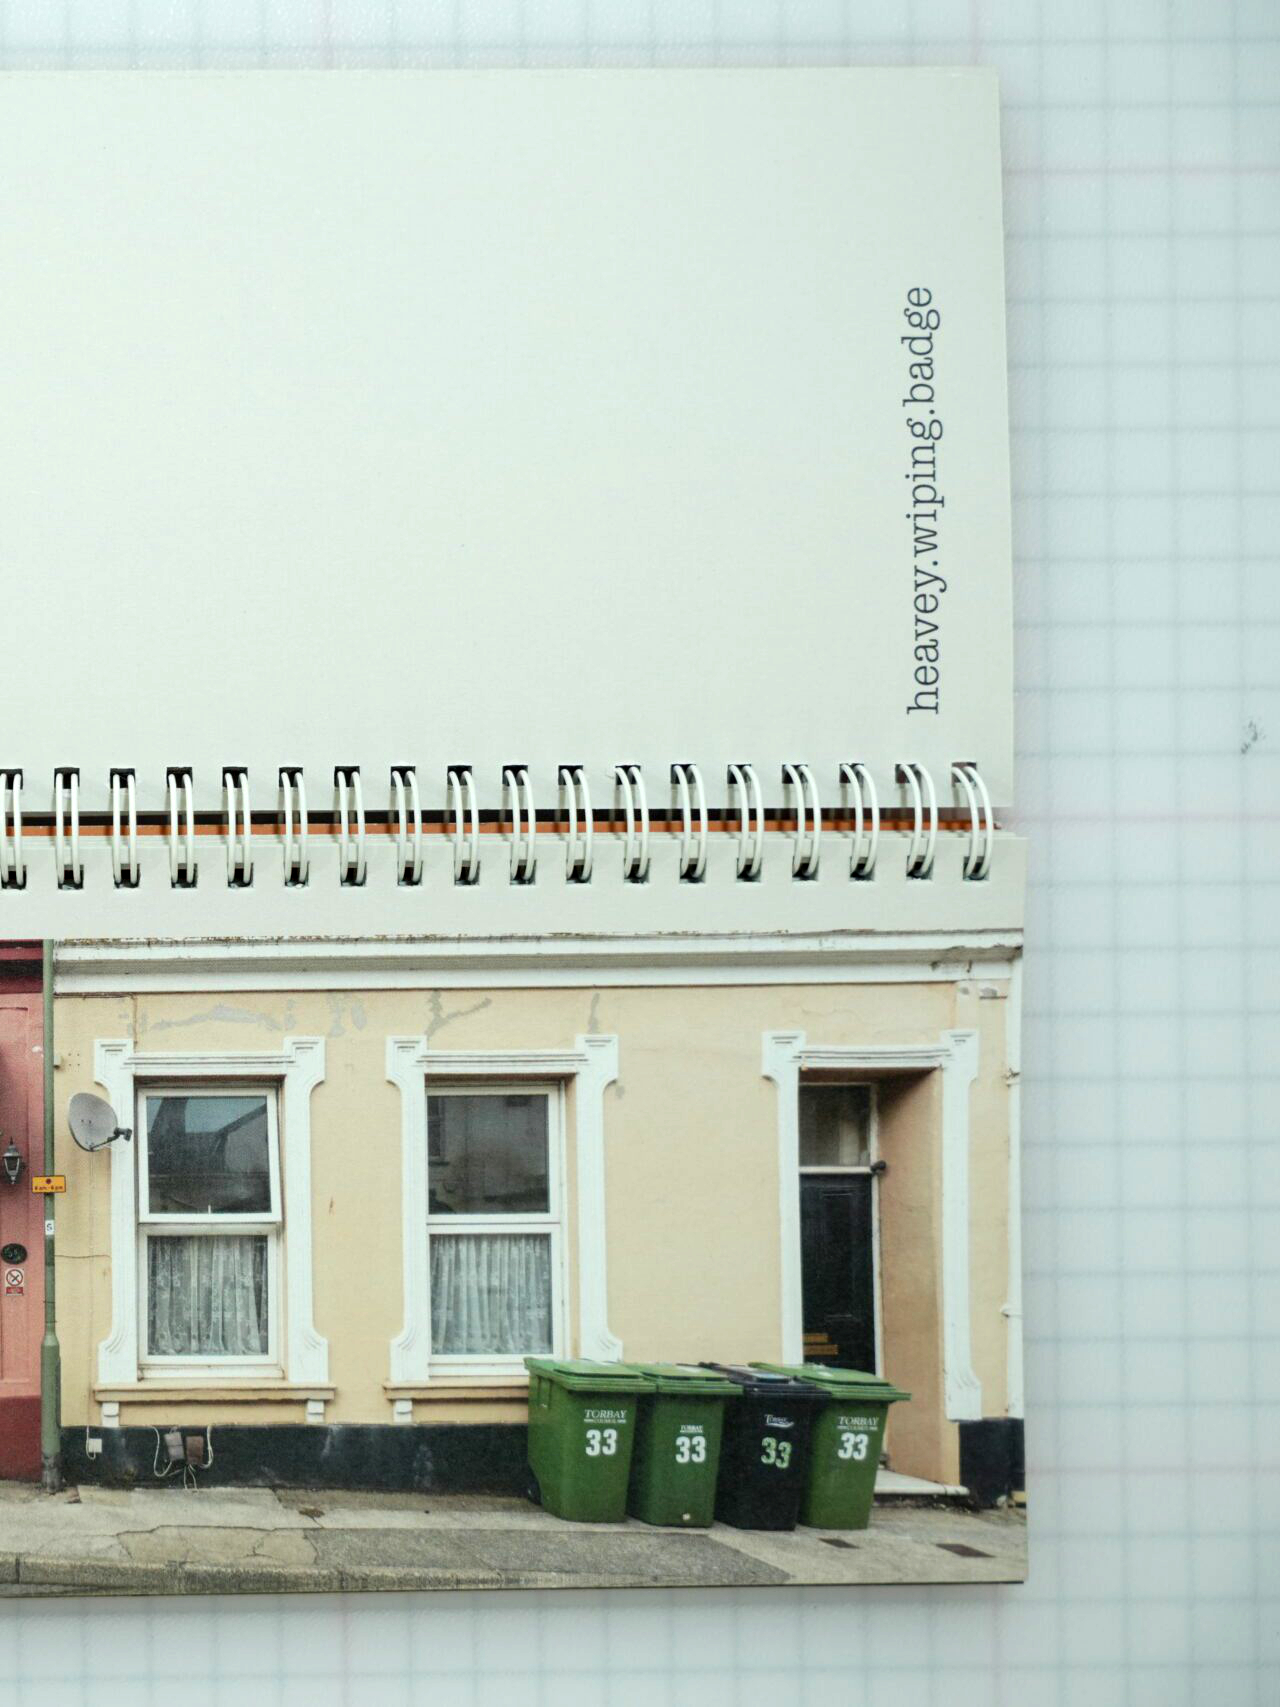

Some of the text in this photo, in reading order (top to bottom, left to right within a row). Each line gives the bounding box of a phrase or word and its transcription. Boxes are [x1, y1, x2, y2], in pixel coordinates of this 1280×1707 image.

[901, 287, 947, 714] heavey.wiping.badge
[584, 1409, 627, 1419] TORBAY
[839, 1416, 879, 1425] TORBAY
[585, 1428, 618, 1456] 33
[675, 1435, 707, 1463] 33
[760, 1436, 793, 1469] 33
[838, 1432, 869, 1460] 33
